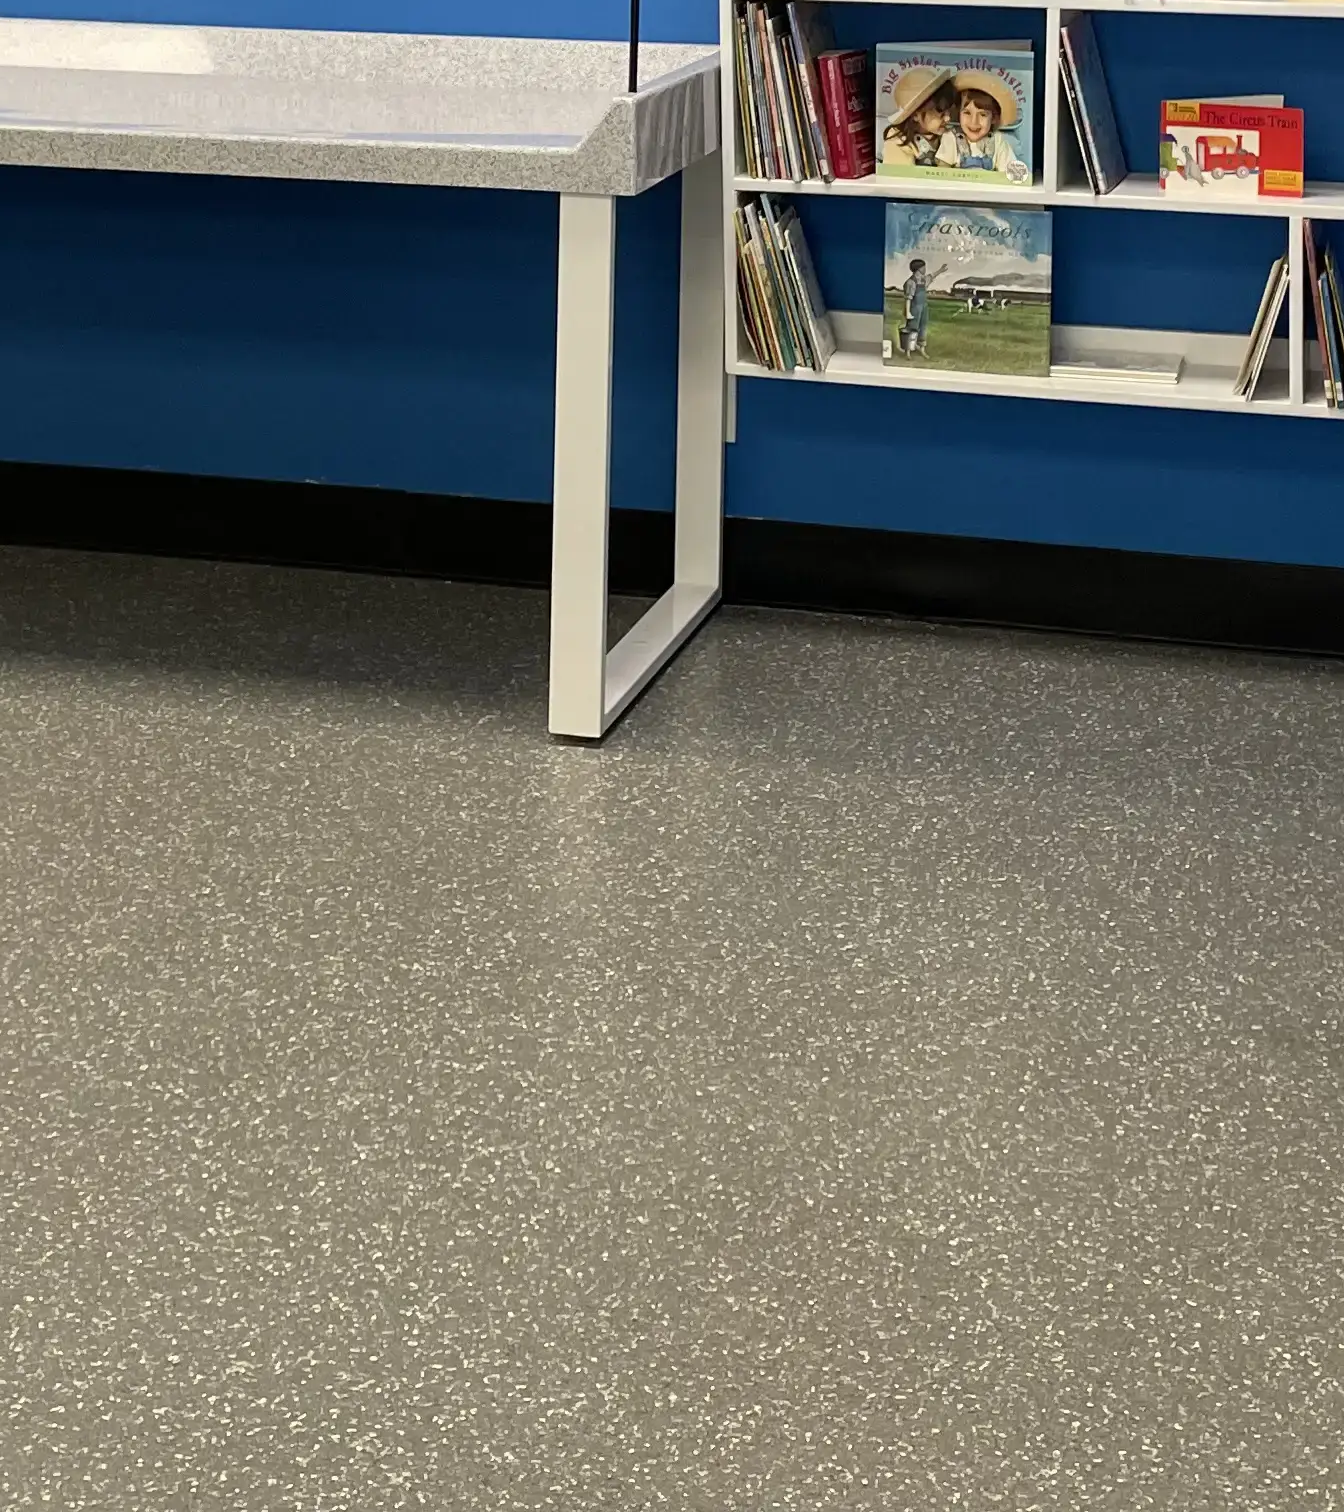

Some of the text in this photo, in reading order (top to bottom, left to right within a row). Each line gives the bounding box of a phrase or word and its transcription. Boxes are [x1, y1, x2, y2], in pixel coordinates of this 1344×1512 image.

[882, 68, 899, 95] Big
[1204, 111, 1226, 125] The
[1229, 112, 1266, 128] Circus
[1267, 114, 1298, 129] Train
[907, 211, 1033, 239] Grassroots
